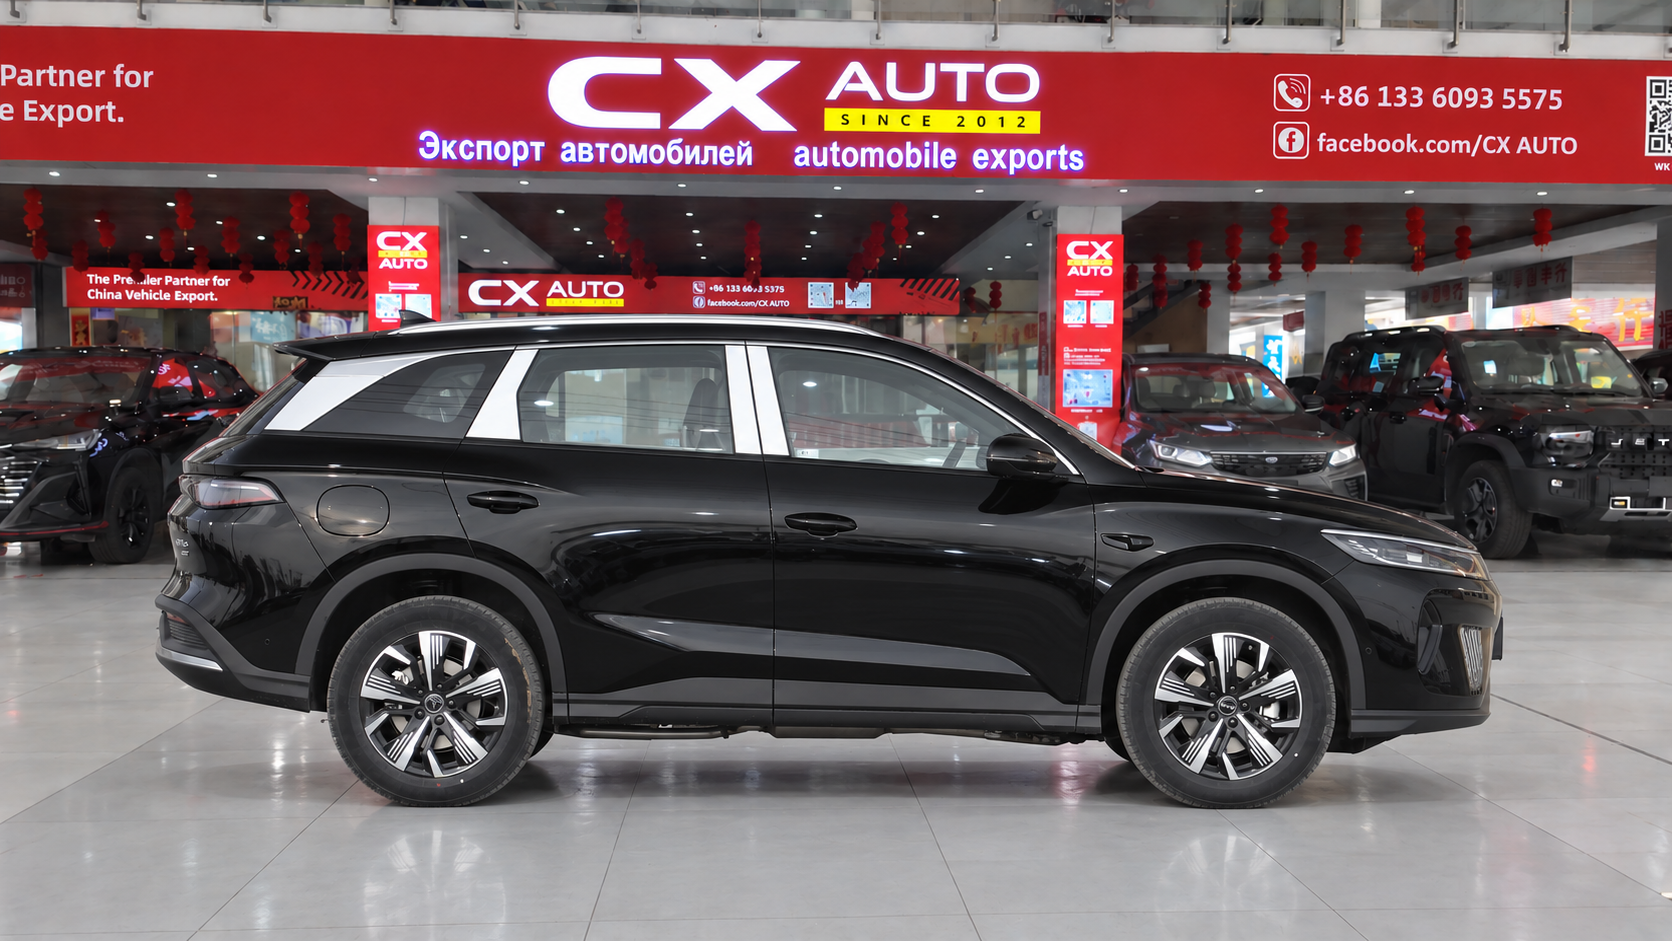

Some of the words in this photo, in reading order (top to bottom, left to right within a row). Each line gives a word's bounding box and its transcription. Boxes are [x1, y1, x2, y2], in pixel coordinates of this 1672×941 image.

[1, 64, 105, 87] Partner
[113, 64, 153, 87] for
[826, 61, 1040, 103] AUTO
[547, 57, 801, 131] CX
[1320, 86, 1368, 106] +86
[1378, 86, 1423, 107] 133
[1432, 87, 1493, 108] 6093
[1503, 89, 1563, 110] 5575
[24, 100, 124, 127] Export.
[841, 114, 931, 127] SINCE
[957, 116, 1026, 128] 2012
[418, 130, 545, 166] Экспорт
[561, 138, 753, 166] автомобилей
[1317, 132, 1510, 157] facebook.com/CX
[1517, 137, 1578, 155] AUTO
[794, 142, 957, 169] automobile
[972, 145, 1084, 175] exports
[376, 231, 427, 251] CX
[1066, 241, 1113, 260] CX
[378, 258, 428, 270] AUTO
[1067, 266, 1113, 277] AUTO
[87, 274, 110, 285] The
[165, 276, 209, 287] Partner
[212, 275, 231, 287] for
[546, 281, 624, 298] AUTO
[87, 289, 122, 300] China
[125, 290, 171, 301] Vehicle
[175, 291, 218, 303] Export.
[468, 279, 540, 307] CX
